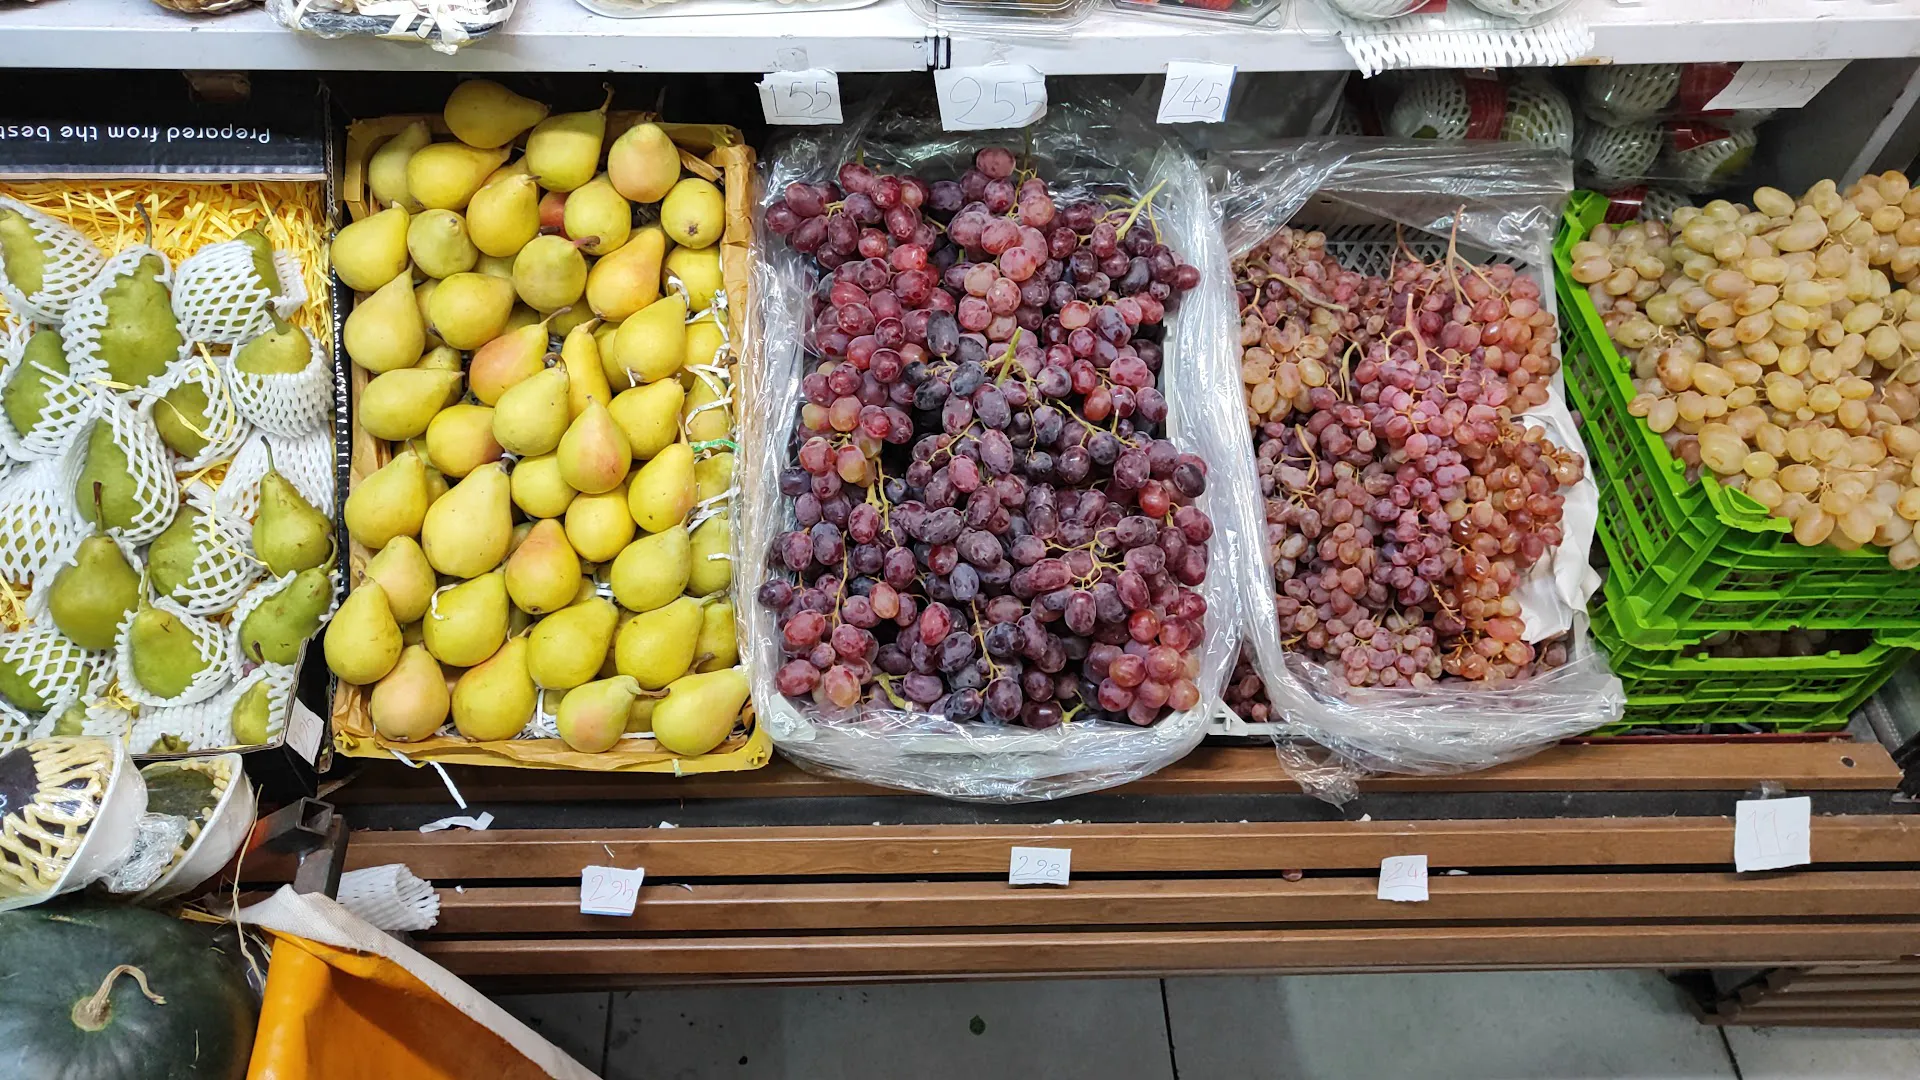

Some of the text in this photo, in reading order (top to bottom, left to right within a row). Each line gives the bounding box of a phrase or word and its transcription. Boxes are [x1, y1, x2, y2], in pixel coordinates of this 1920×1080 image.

[769, 81, 832, 115] 155
[949, 76, 1045, 125] 255
[0, 123, 271, 144] Prepared from the best
[1012, 855, 1061, 877] 298
[589, 874, 635, 903] 295
